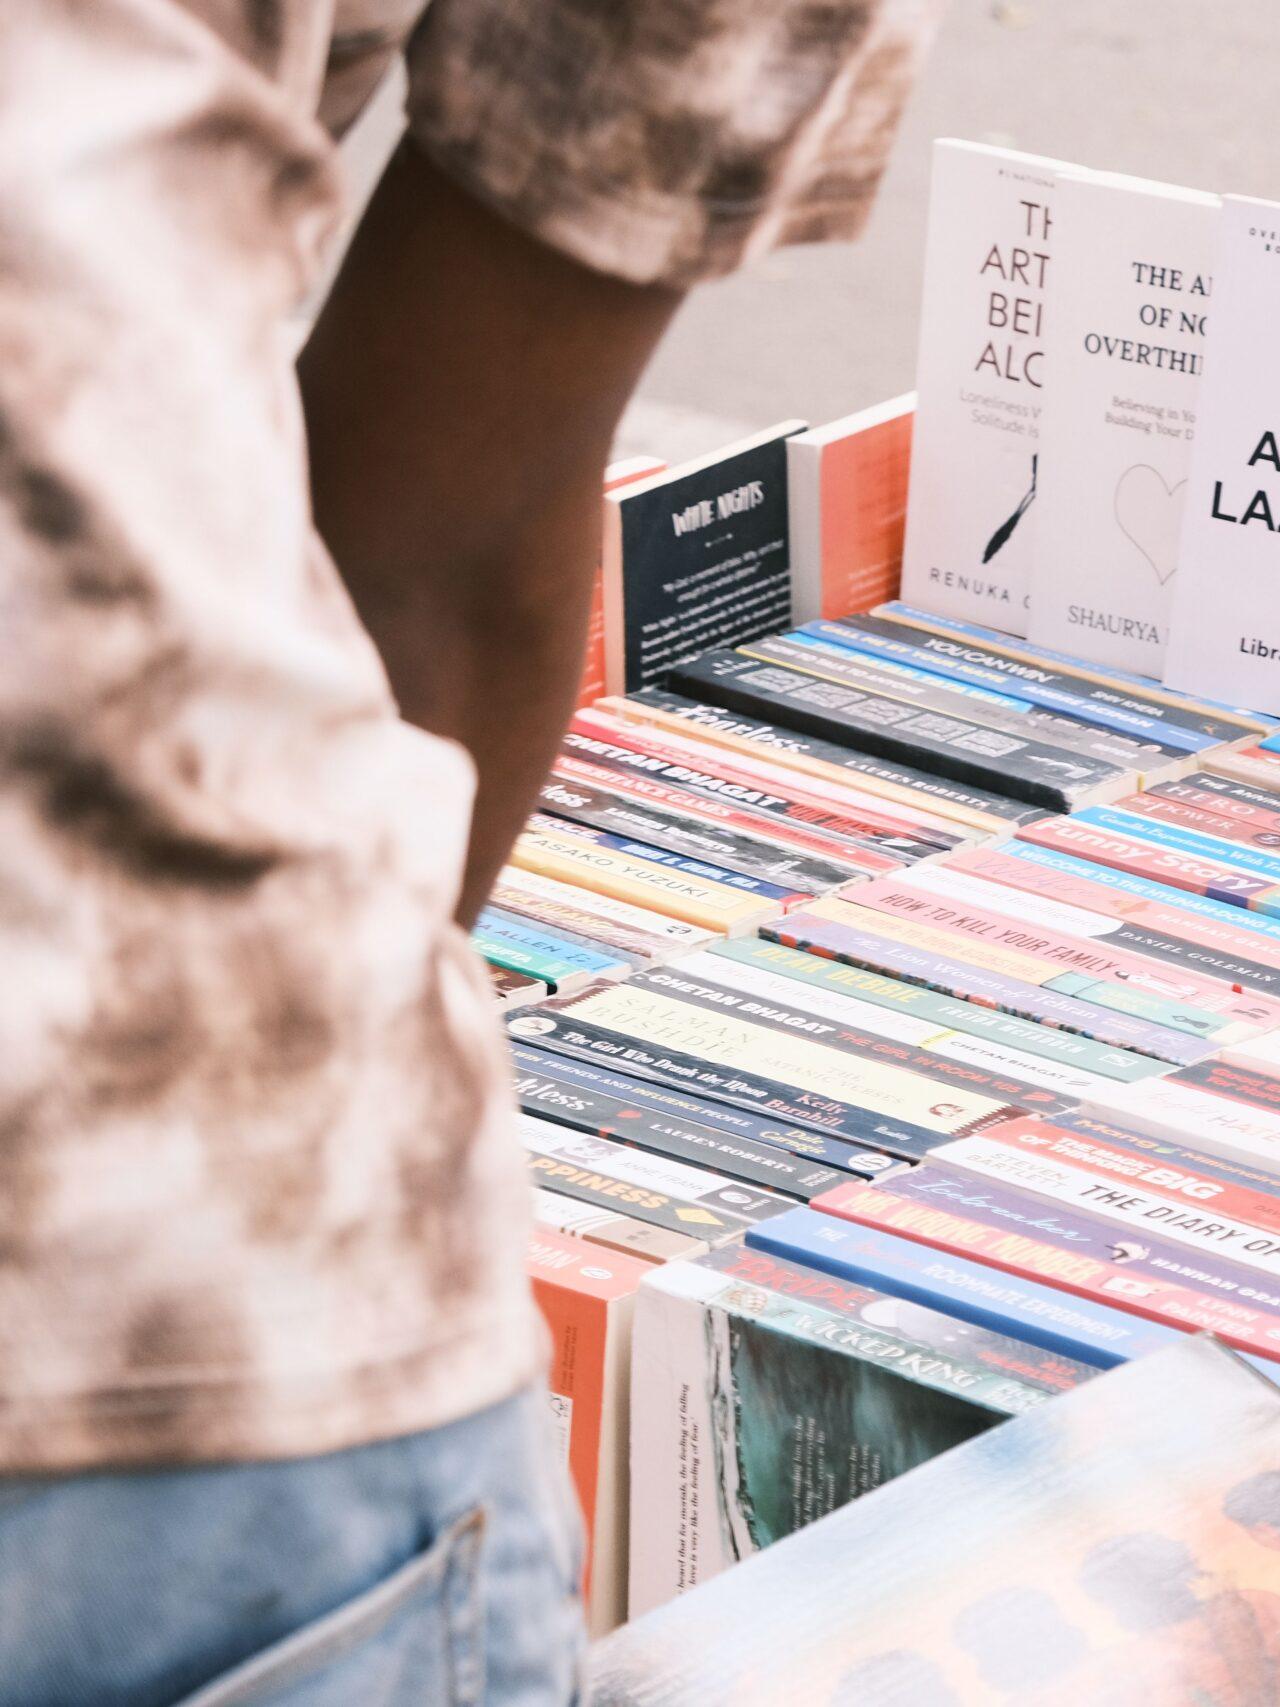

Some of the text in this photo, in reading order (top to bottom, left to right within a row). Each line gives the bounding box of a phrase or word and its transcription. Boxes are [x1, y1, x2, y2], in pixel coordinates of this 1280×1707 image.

[979, 242, 1051, 289] ART
[1132, 261, 1183, 292] THE
[986, 291, 1044, 338] BEI
[1138, 304, 1173, 329] OF
[1083, 332, 1203, 377] OVERTHI
[959, 387, 1028, 416] Loneliness
[970, 408, 1024, 435] Solitude
[1104, 411, 1153, 434] Building
[1111, 394, 1164, 419] Believing
[929, 566, 1012, 604] RENUKA
[1067, 604, 1160, 645] SHAURYA
[676, 703, 811, 755] Fearless
[663, 759, 791, 811] BHAGAT
[844, 759, 993, 809] LAUREN ROBERTS
[1164, 783, 1257, 818] HERO
[1196, 777, 1230, 795] THE
[533, 838, 615, 867] ASAKO
[621, 866, 711, 898] YUZUKI
[1020, 849, 1096, 880] WELCOME
[1032, 819, 1266, 892] Funny Story
[1228, 849, 1264, 868] With
[494, 928, 562, 954] ALLEN
[949, 911, 995, 937] KILL
[998, 925, 1052, 958] YOUR
[1040, 940, 1121, 975] FAMILY
[1118, 930, 1278, 983] DANIEL GOLEMAN
[752, 945, 822, 977] DEAR
[825, 964, 929, 1004] DEBBIE
[884, 947, 1006, 992] Lion Women
[648, 972, 745, 1008] CHETAN
[741, 999, 838, 1036] BHAGAT
[834, 1031, 874, 1051] THE
[933, 1060, 987, 1087] ROOM
[541, 1058, 754, 1129] FRIENDS INFLUENCE PEOPLE
[763, 1099, 846, 1130] Barnhill
[796, 1092, 850, 1116] Kelly
[648, 1122, 797, 1175] LAUREN ROBERTS
[1139, 1165, 1225, 1201] BIG
[910, 1177, 1092, 1243] Icebreaker
[1079, 1184, 1147, 1210] THE
[1140, 1206, 1245, 1242] DIARY
[988, 1235, 1106, 1284] NUMBER
[1150, 1256, 1238, 1290] HANNAH
[793, 1309, 985, 1390] WICKED KING
